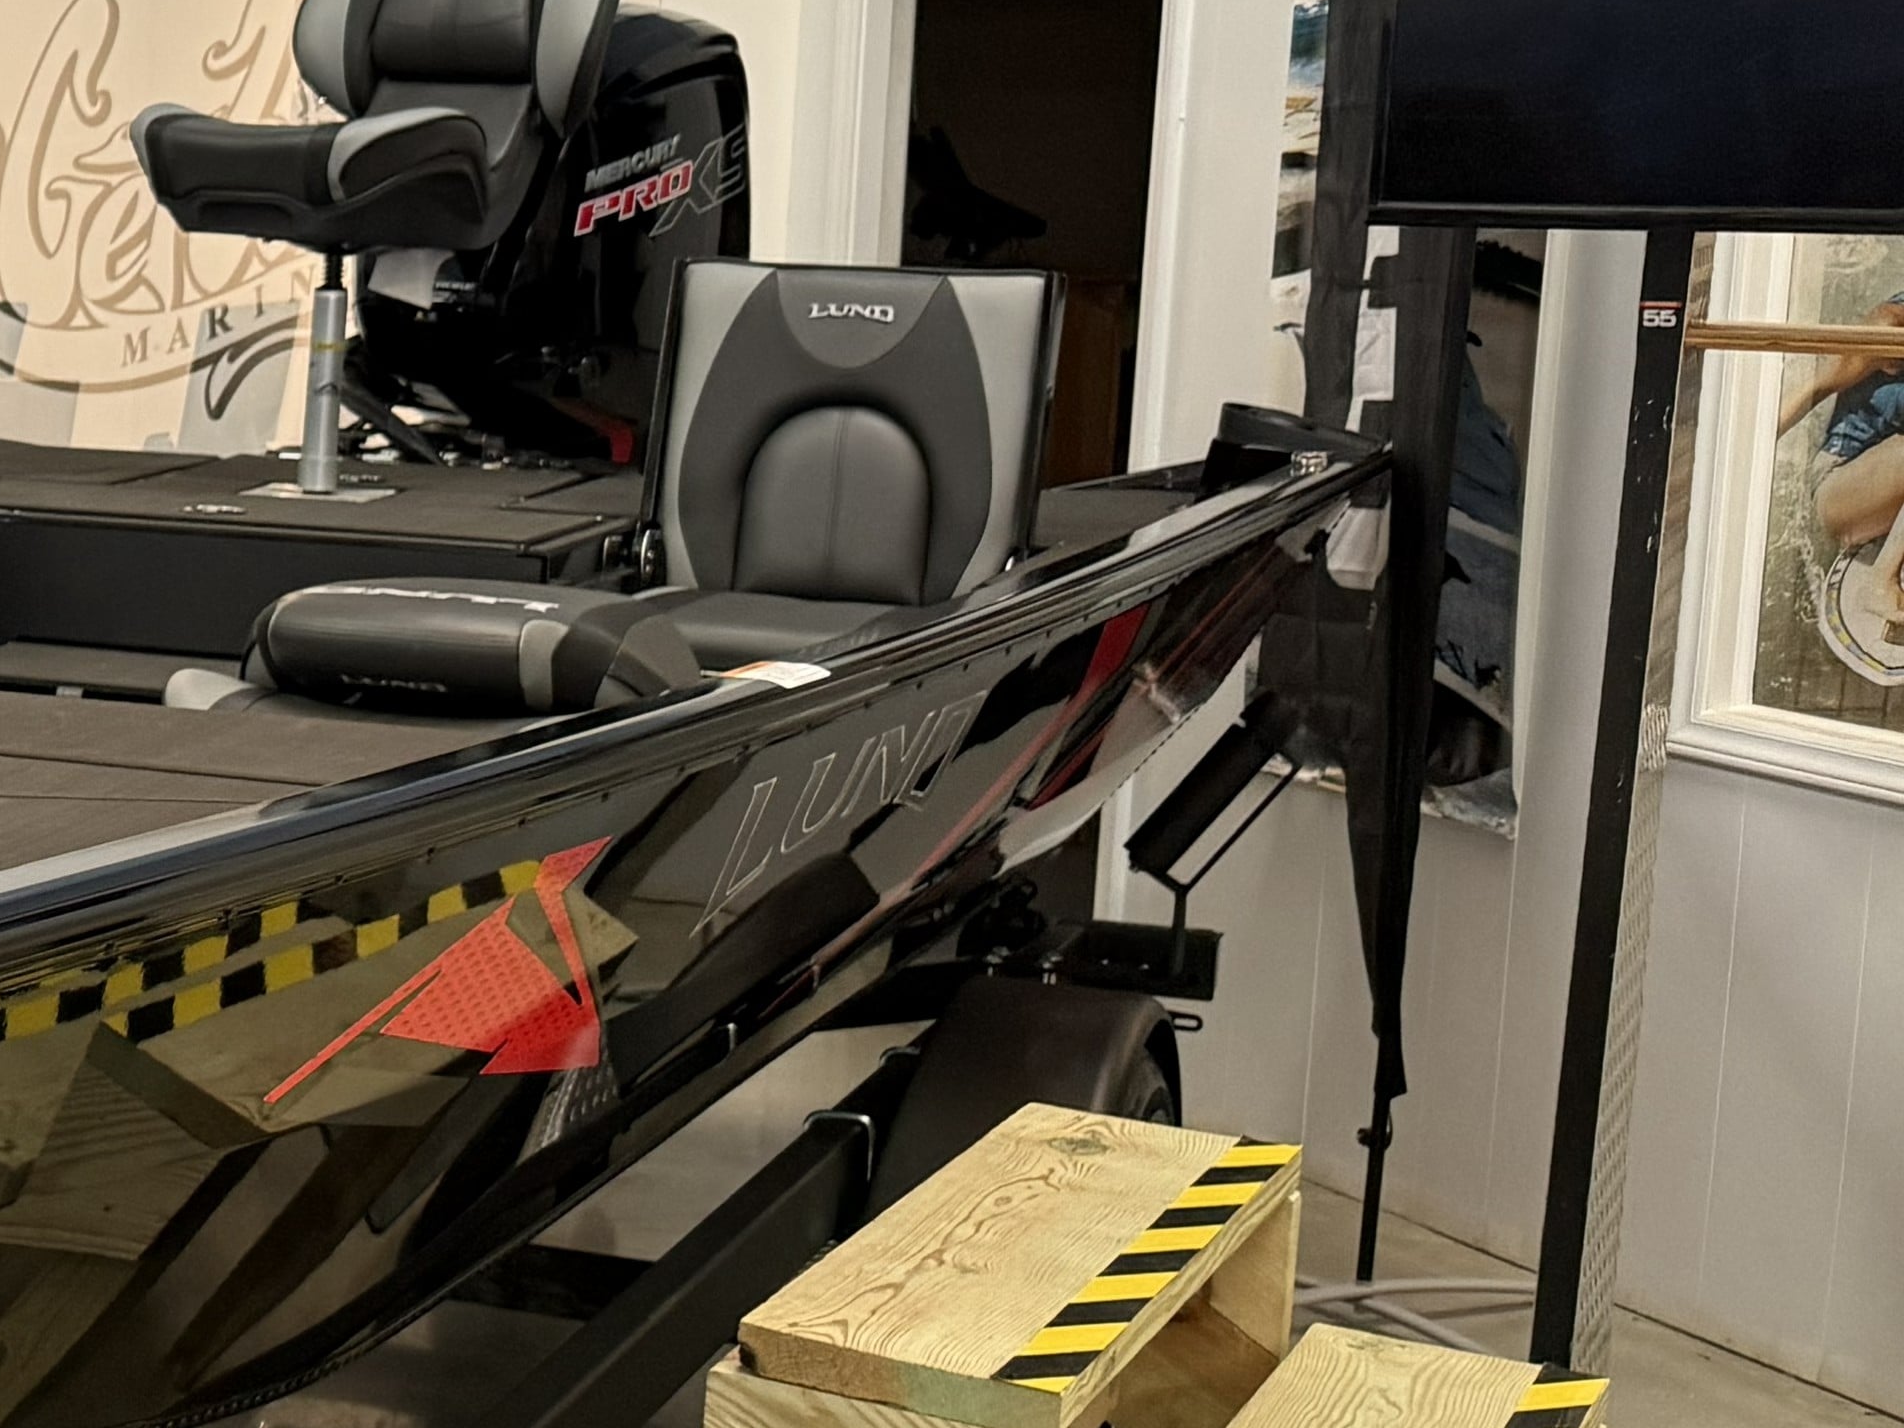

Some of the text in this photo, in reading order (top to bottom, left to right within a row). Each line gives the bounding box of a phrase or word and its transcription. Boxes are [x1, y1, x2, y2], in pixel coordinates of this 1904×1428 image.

[583, 131, 682, 193] MERCURY
[573, 158, 694, 238] PRO
[120, 264, 317, 368] MARIN
[808, 302, 895, 323] LUND
[1642, 309, 1677, 327] 55
[688, 688, 990, 939] LUND
